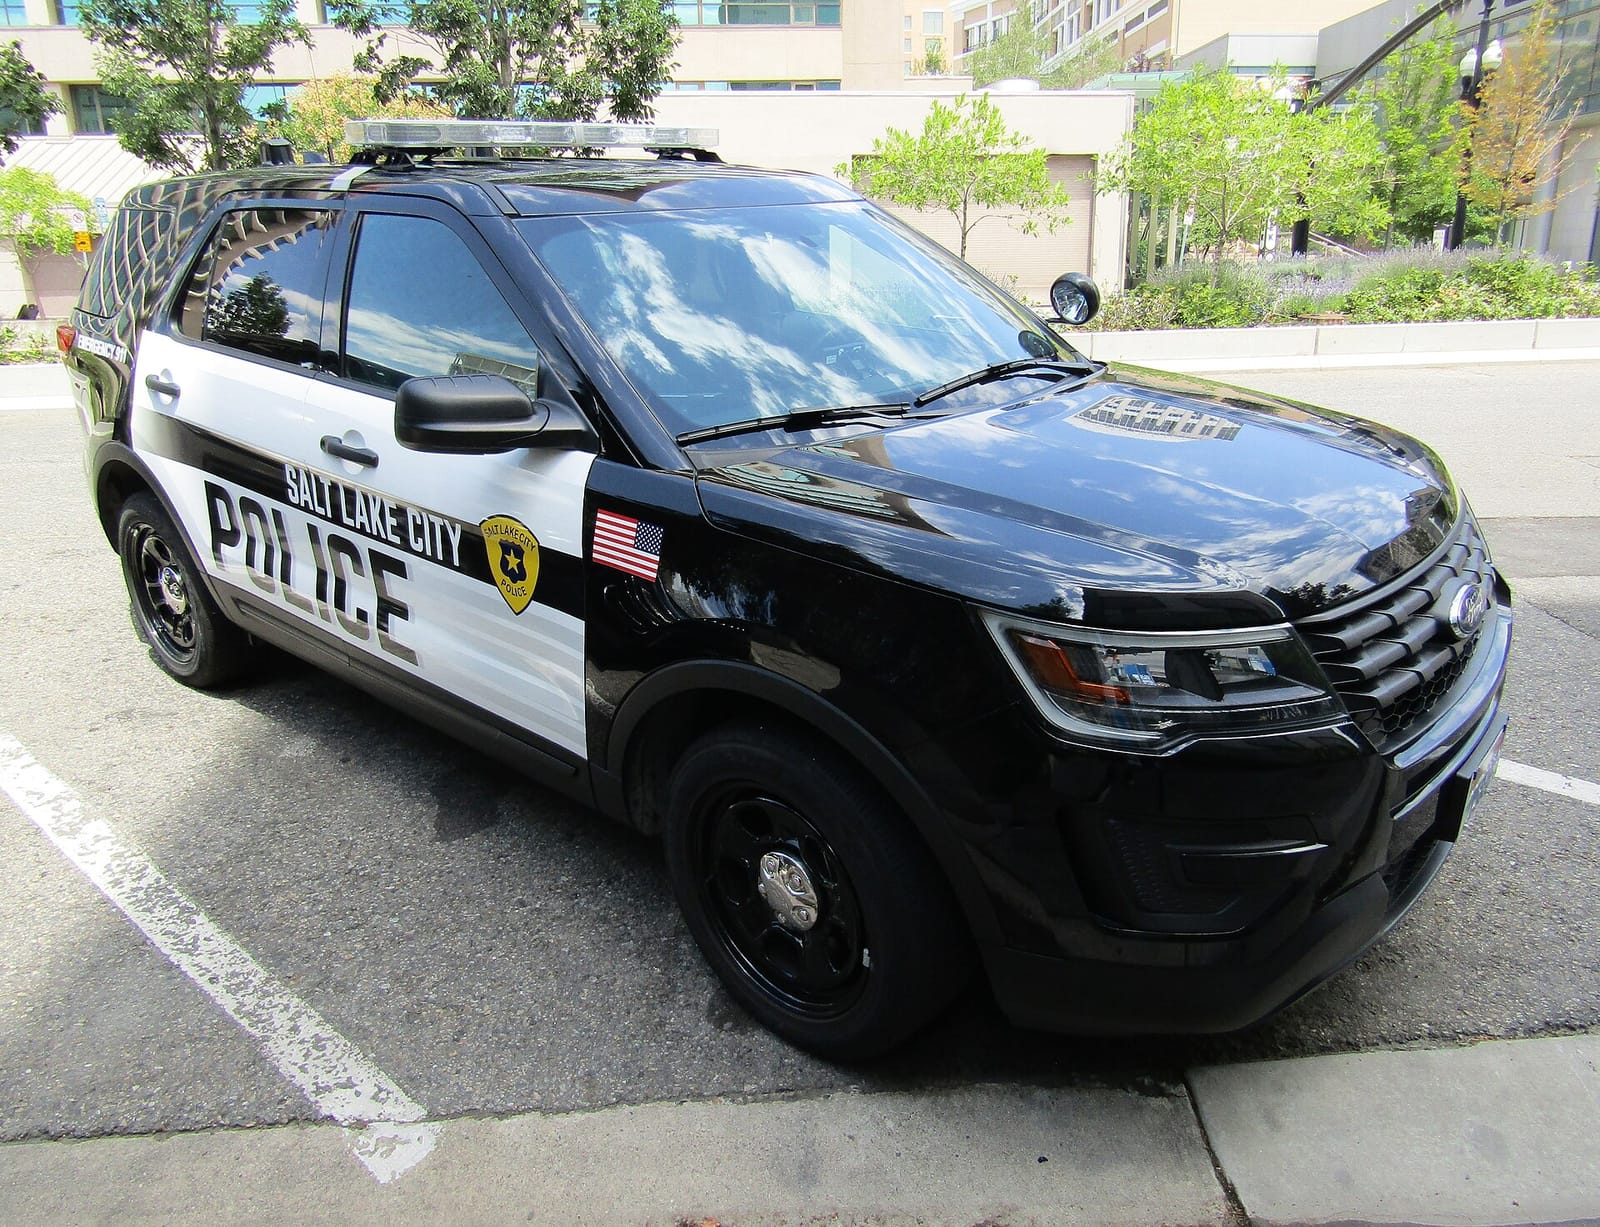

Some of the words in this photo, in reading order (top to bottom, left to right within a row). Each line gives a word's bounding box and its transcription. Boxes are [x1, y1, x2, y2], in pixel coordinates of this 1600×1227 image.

[284, 463, 333, 519] SALT
[336, 481, 401, 545] LAKE
[406, 506, 462, 567] CITY
[484, 524, 499, 538] SALT
[500, 524, 520, 540] LAKE
[519, 533, 536, 552] CITY
[203, 479, 422, 667] POLICE
[500, 578, 528, 598] POLICE
